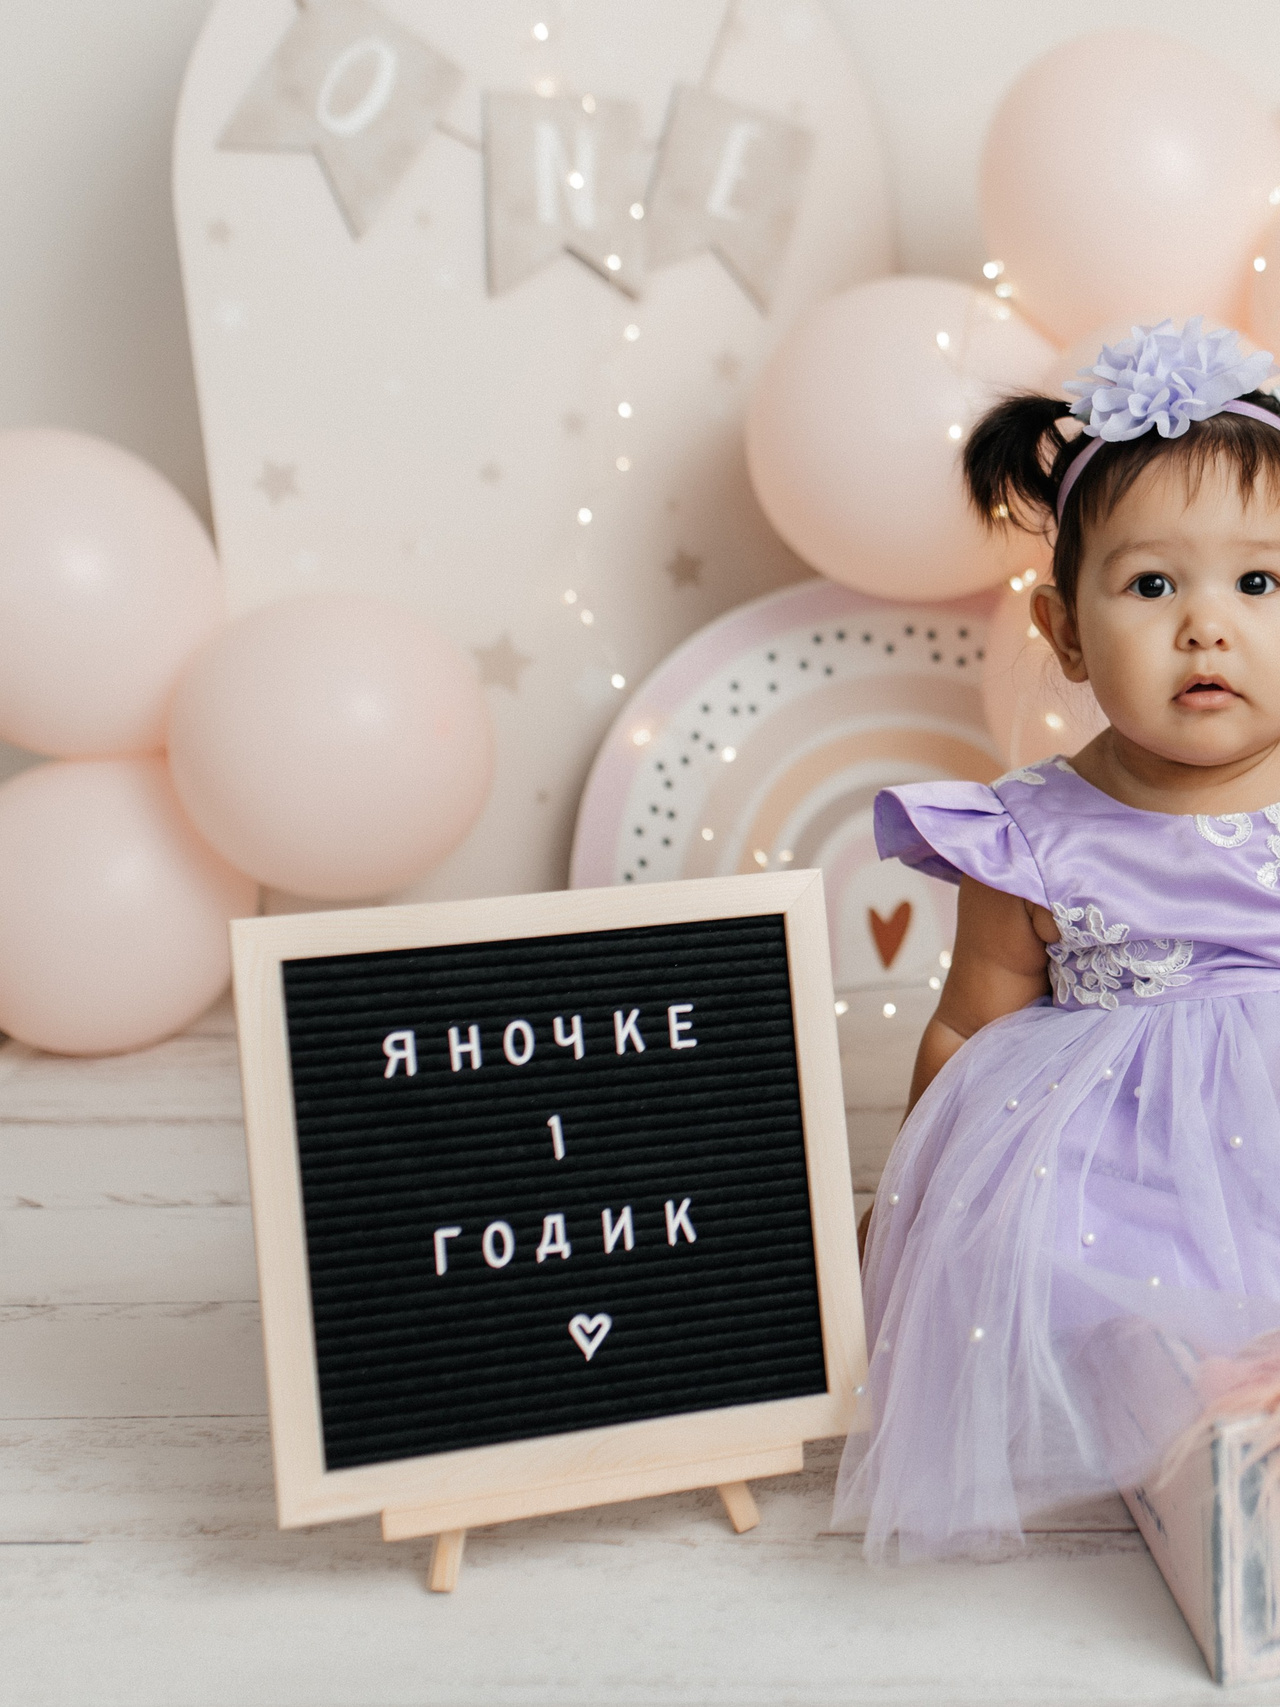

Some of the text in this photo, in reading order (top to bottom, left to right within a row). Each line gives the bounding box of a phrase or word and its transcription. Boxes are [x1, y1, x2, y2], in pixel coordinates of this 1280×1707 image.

[317, 38, 760, 229] ONE
[382, 1004, 698, 1079] ЯНОЧКЕ
[546, 1114, 566, 1161] 1
[433, 1197, 697, 1276] ГОДИК
